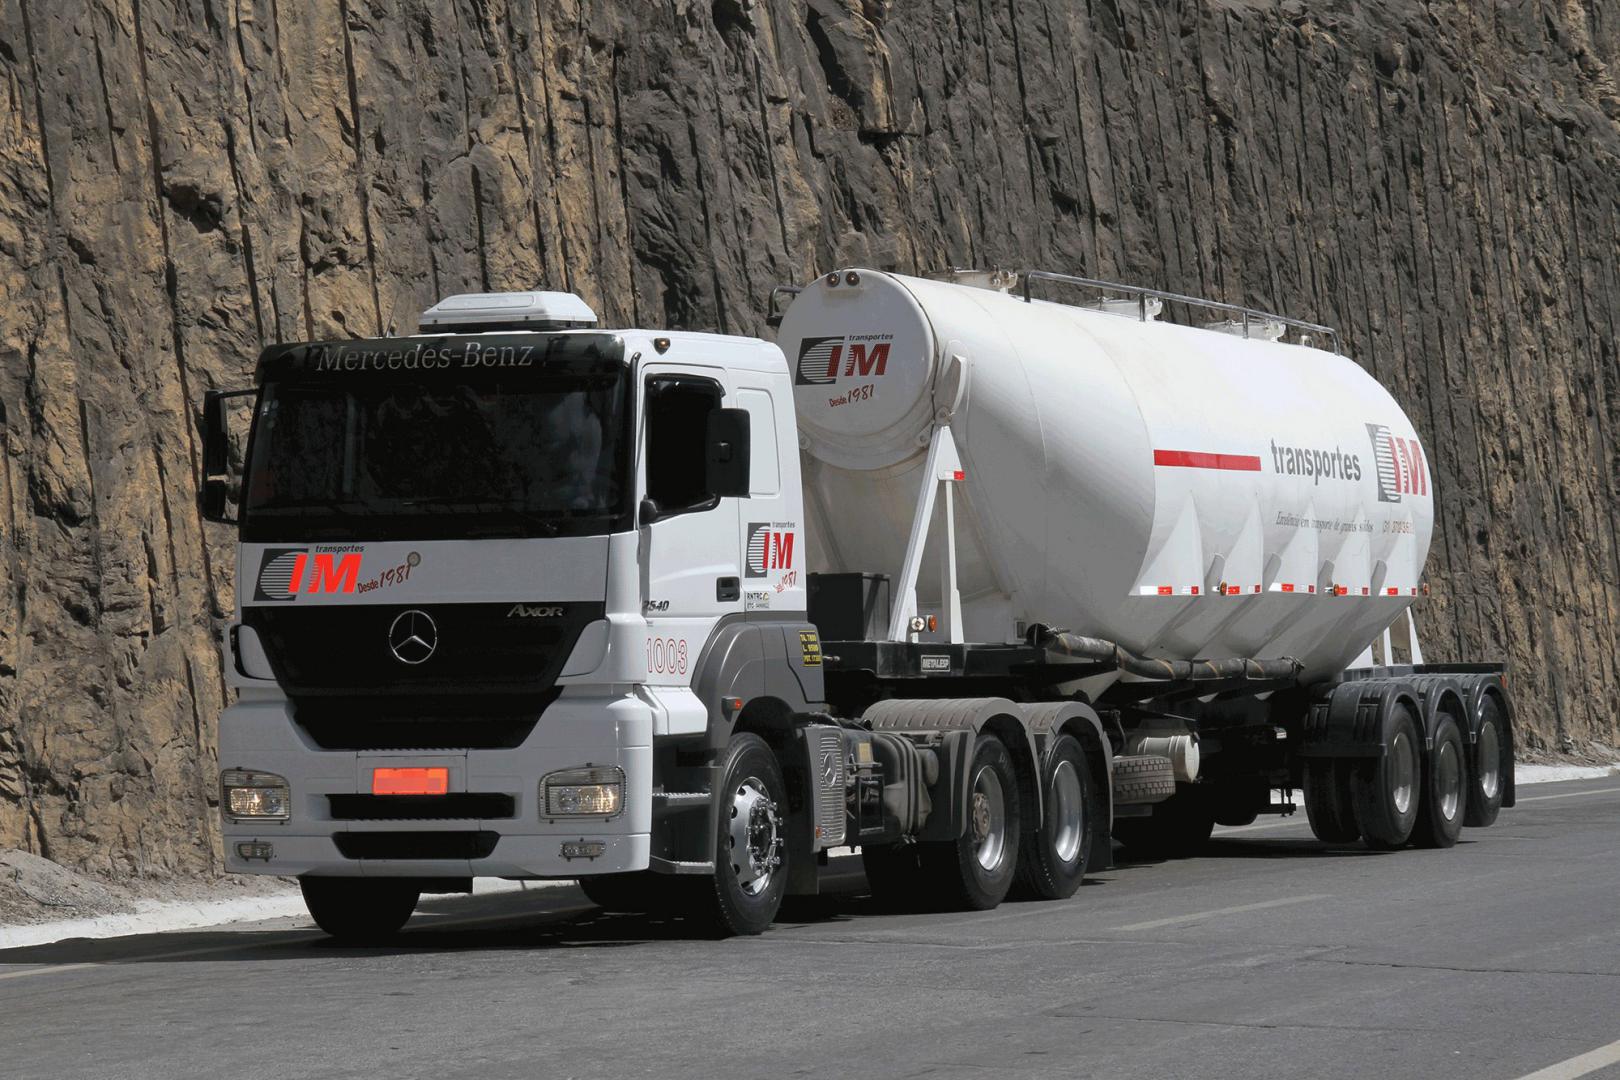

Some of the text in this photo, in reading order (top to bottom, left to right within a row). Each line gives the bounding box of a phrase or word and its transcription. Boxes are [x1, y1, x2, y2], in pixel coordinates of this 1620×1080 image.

[848, 333, 893, 342] transportes
[316, 342, 535, 371] Mercedes-Benz
[847, 384, 874, 403] 1981
[1271, 437, 1362, 486] transportes
[315, 545, 365, 554] transportes
[357, 562, 412, 594] Desde 1981
[646, 638, 688, 675] 1003
